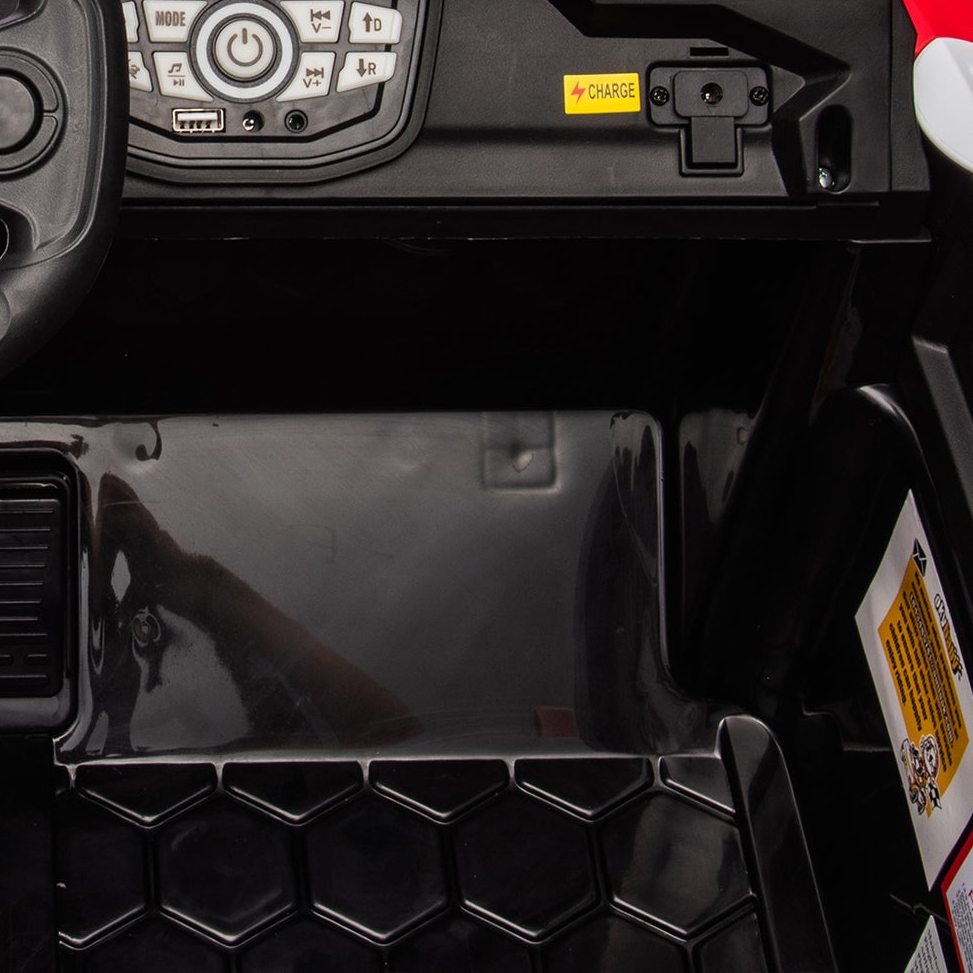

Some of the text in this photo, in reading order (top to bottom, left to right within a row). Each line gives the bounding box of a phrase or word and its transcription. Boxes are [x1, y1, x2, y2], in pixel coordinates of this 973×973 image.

[155, 10, 187, 27] MODE
[374, 17, 382, 32] D
[368, 62, 376, 76] R
[588, 82, 636, 100] CHARGE
